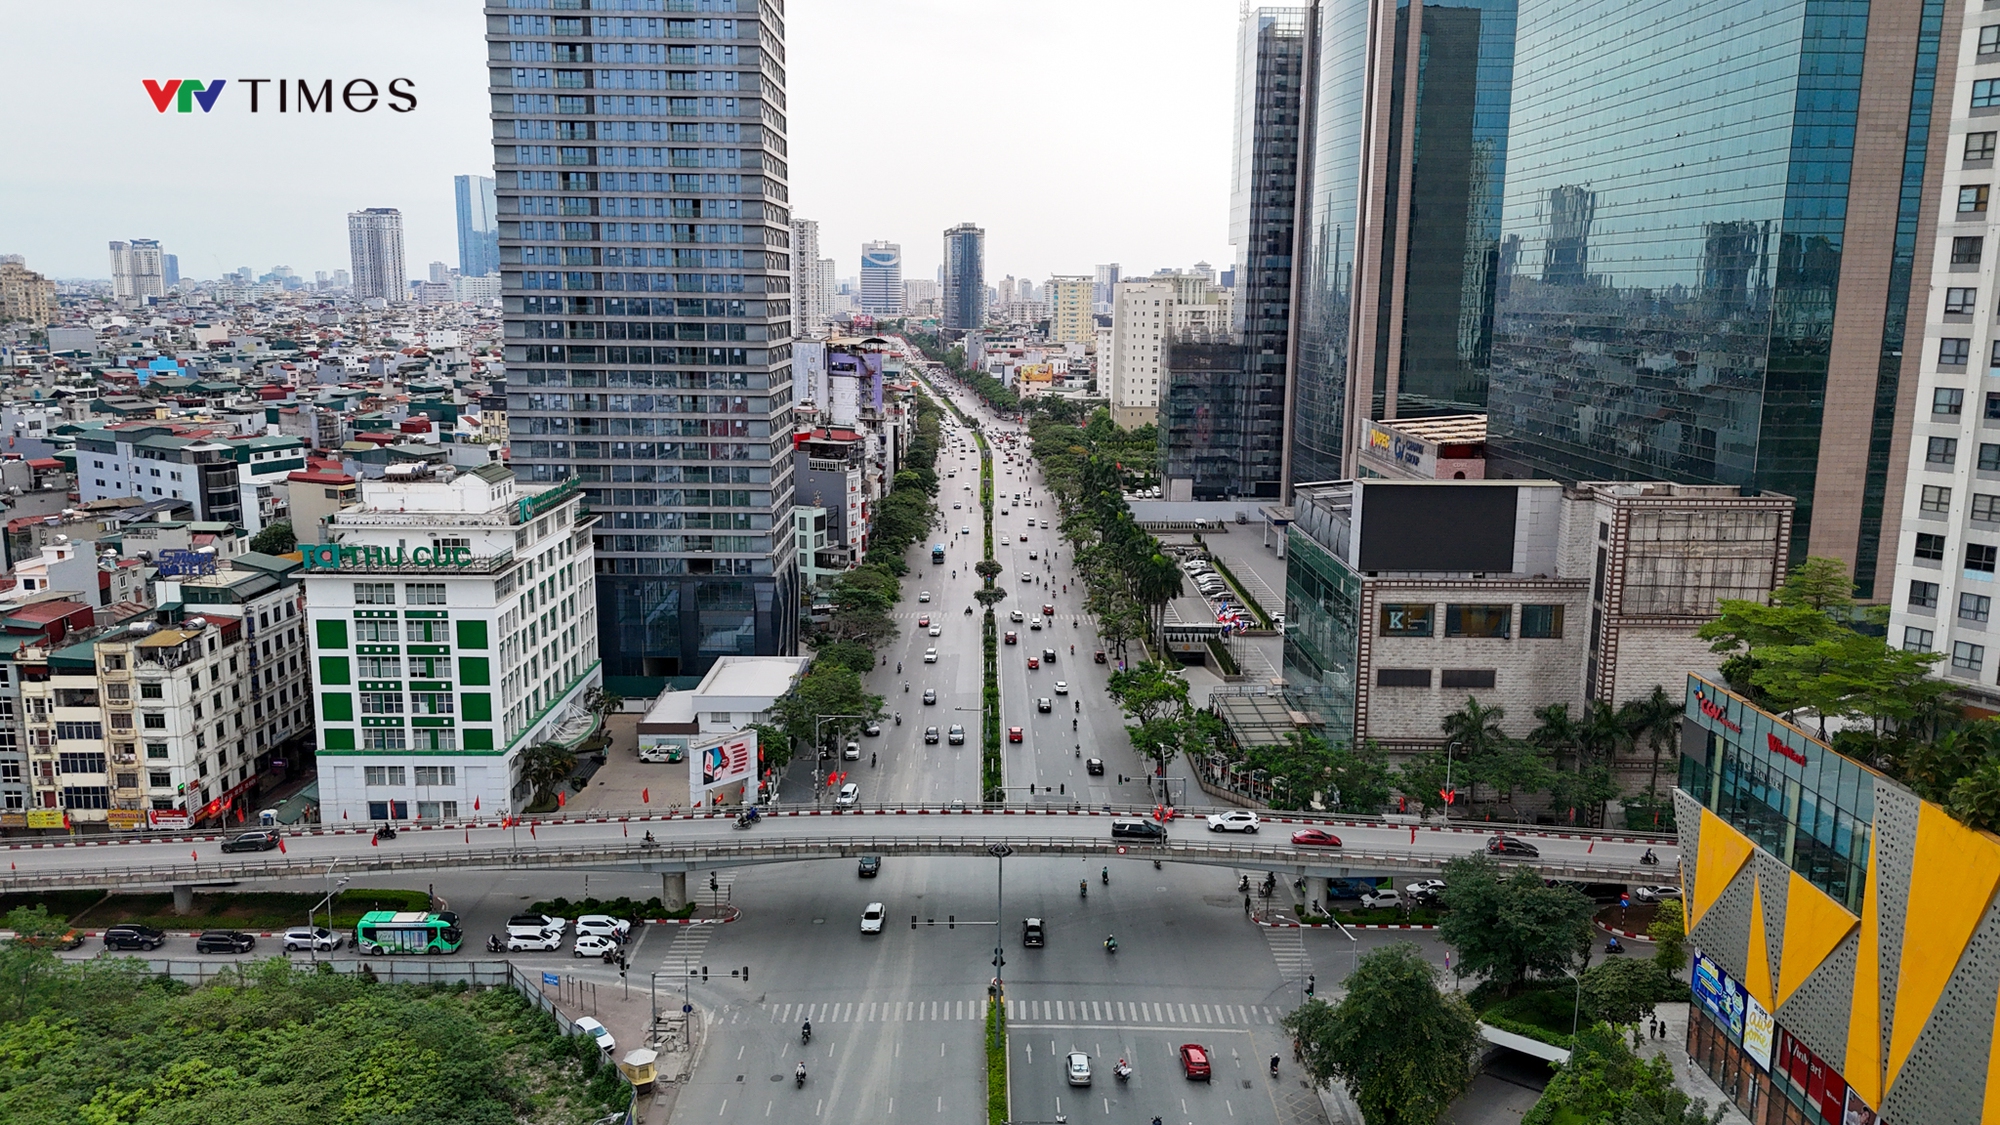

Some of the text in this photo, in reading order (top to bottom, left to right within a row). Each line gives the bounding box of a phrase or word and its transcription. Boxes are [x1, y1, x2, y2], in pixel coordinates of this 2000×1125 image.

[1389, 611, 1404, 629] K
[1701, 698, 1723, 720] CGV
[1767, 733, 1806, 767] WinMart
